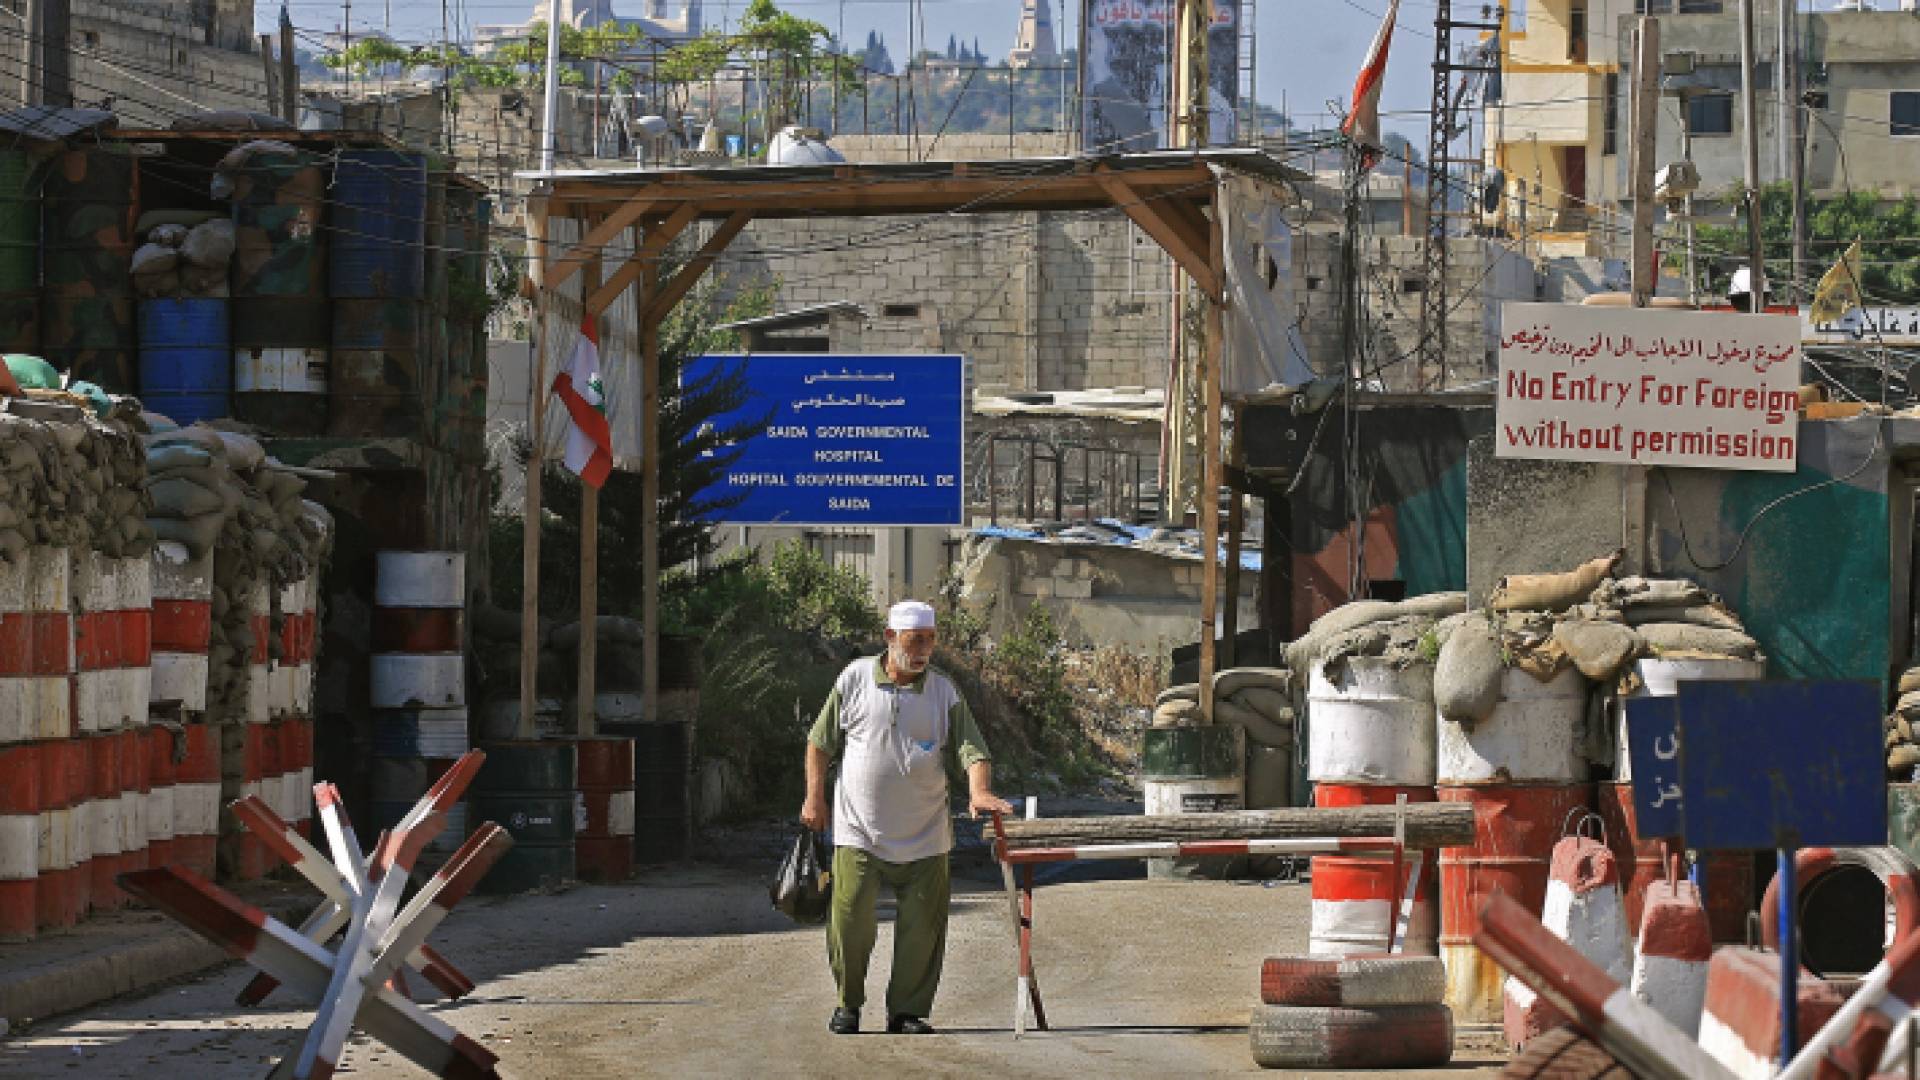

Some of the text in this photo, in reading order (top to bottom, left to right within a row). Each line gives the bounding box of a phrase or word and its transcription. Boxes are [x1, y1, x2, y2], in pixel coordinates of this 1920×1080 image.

[1706, 339, 1751, 366] دخول
[1755, 344, 1794, 373] ممنوع
[1506, 369, 1799, 424] No Entry For Foreign
[767, 426, 930, 438] SAIDA GOVERNMENTAL
[1504, 419, 1795, 460] without permission
[815, 450, 883, 463] HOSPITAL
[795, 474, 928, 487] GOUVERNEMENTAL
[936, 474, 955, 487] DE
[828, 497, 870, 510] SAIDA
